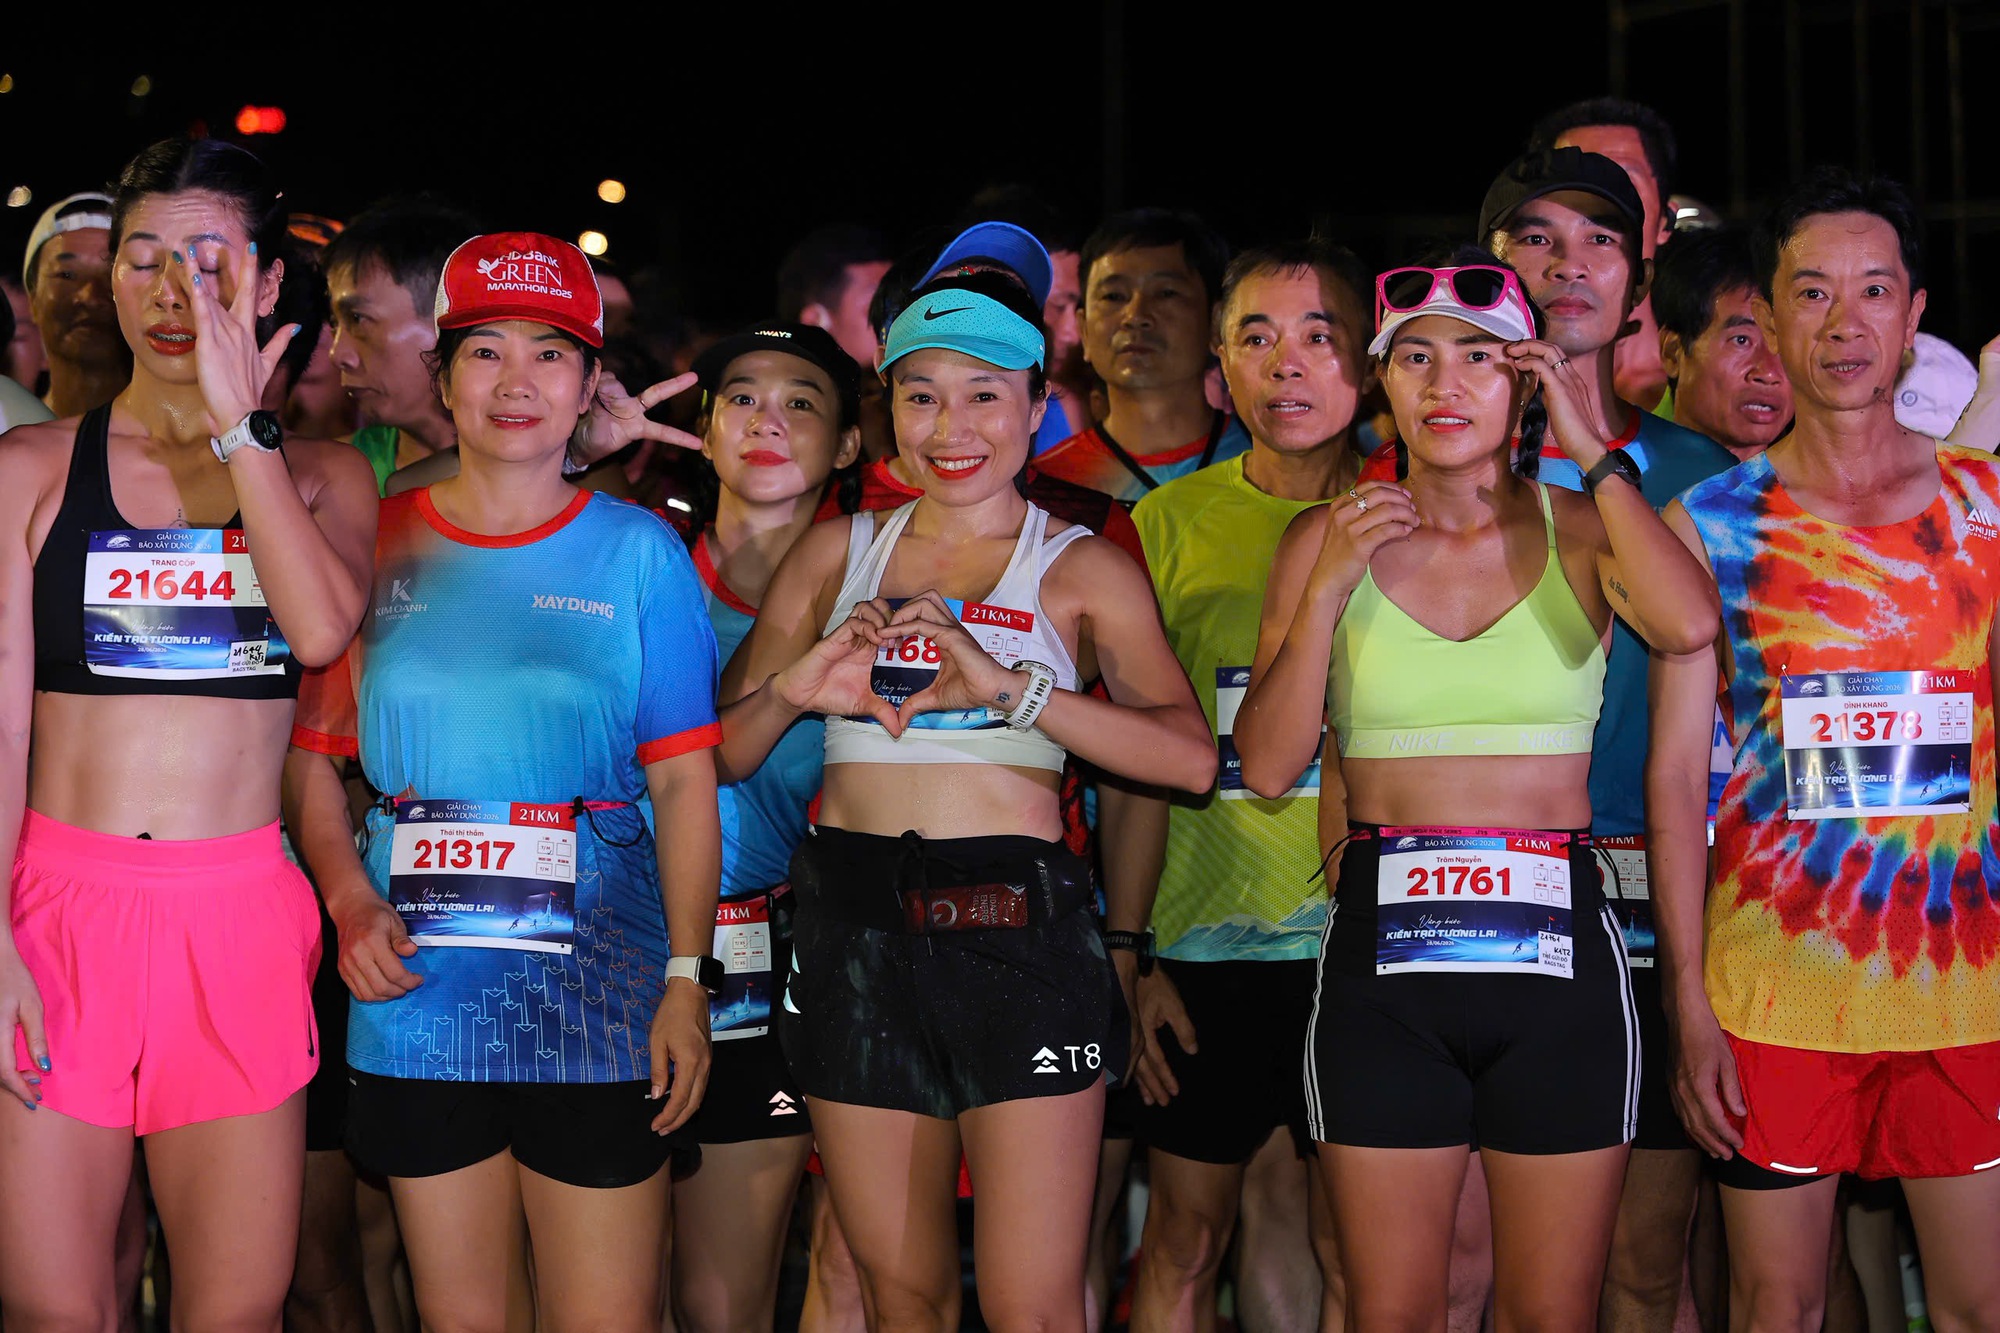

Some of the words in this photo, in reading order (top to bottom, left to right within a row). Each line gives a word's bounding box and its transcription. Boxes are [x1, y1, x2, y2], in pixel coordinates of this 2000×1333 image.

[487, 262, 562, 287] GREEN
[487, 282, 548, 294] MARATHON
[550, 288, 573, 299] 2025
[156, 532, 172, 541] GIẢI
[138, 541, 154, 550] BÁO
[154, 540, 170, 549] XÂY
[170, 542, 193, 550] DỰNG
[151, 559, 178, 567] TRANG
[178, 558, 196, 567] CỐP
[108, 568, 236, 600] 21644
[374, 606, 393, 617] KIM
[394, 603, 428, 614] OANH
[970, 606, 1012, 624] 21KM
[94, 630, 124, 642] KIẾN
[124, 634, 150, 646] TẠO
[150, 634, 191, 644] TƯƠNG
[192, 636, 211, 644] LAI
[233, 644, 262, 656] 21644
[876, 636, 942, 664] 168
[1848, 676, 1864, 684] GIẢI
[1920, 676, 1956, 688] 21KM
[1846, 684, 1862, 692] XÂY
[1862, 684, 1884, 693] DỰNG
[1809, 710, 1922, 742] 21378
[1389, 731, 1456, 752] NIKE
[1518, 730, 1574, 748] NIKE
[1226, 759, 1240, 768] KIẾ
[1825, 775, 1846, 787] TẠO
[446, 802, 462, 811] GIẢI
[462, 804, 482, 812] CHẠY
[431, 810, 444, 819] BÁO
[444, 811, 459, 819] XÂY
[460, 812, 482, 820] DỰNG
[519, 808, 560, 824] 21KM
[456, 830, 465, 838] thị
[1424, 839, 1439, 847] BÁO
[1440, 838, 1454, 846] XÂY
[1455, 838, 1479, 848] DỰNG
[1515, 838, 1550, 851] 21KM
[414, 839, 516, 870] 21317
[1455, 856, 1482, 864] Nguyễn
[1406, 866, 1510, 896] 21761
[396, 900, 416, 912] KIẾN
[417, 902, 438, 914] TẠO
[438, 902, 474, 912] TƯƠNG
[476, 904, 495, 912] LAI
[716, 907, 750, 920] 21KM
[980, 894, 989, 925] ENERGY
[1386, 927, 1413, 940] KIẾN
[1414, 929, 1437, 940] TẠO
[1437, 928, 1477, 938] TƯƠNG
[1479, 929, 1497, 938] LAI
[1064, 1043, 1101, 1072] T8
